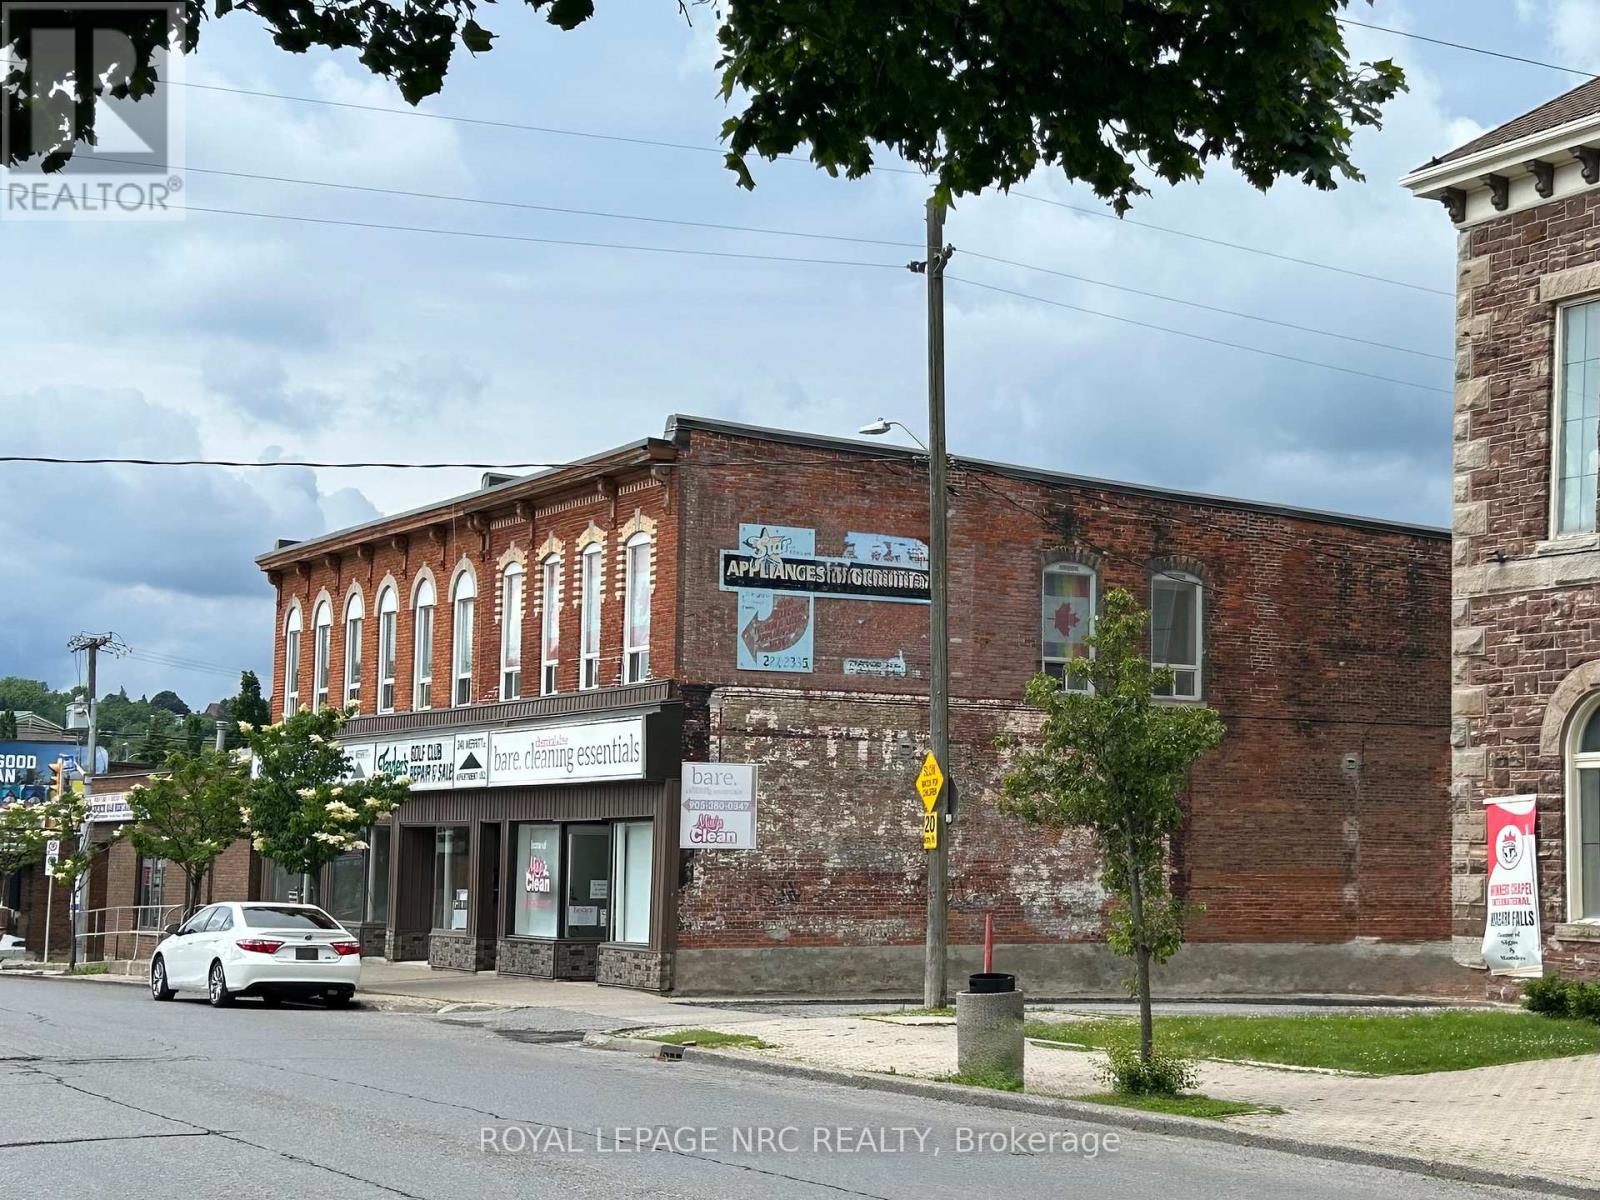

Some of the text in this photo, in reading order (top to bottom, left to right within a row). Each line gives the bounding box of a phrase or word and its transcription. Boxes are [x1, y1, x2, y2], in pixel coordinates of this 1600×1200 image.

[727, 557, 826, 583] APPLIANCES
[411, 743, 442, 762] GOLF CLUB
[494, 733, 640, 773] bare. cleaning essentials
[692, 766, 737, 786] bare.
[924, 815, 935, 833] 20
[690, 828, 738, 844] Clean
[525, 872, 551, 893] Clean
[1512, 910, 1534, 926] FALLS
